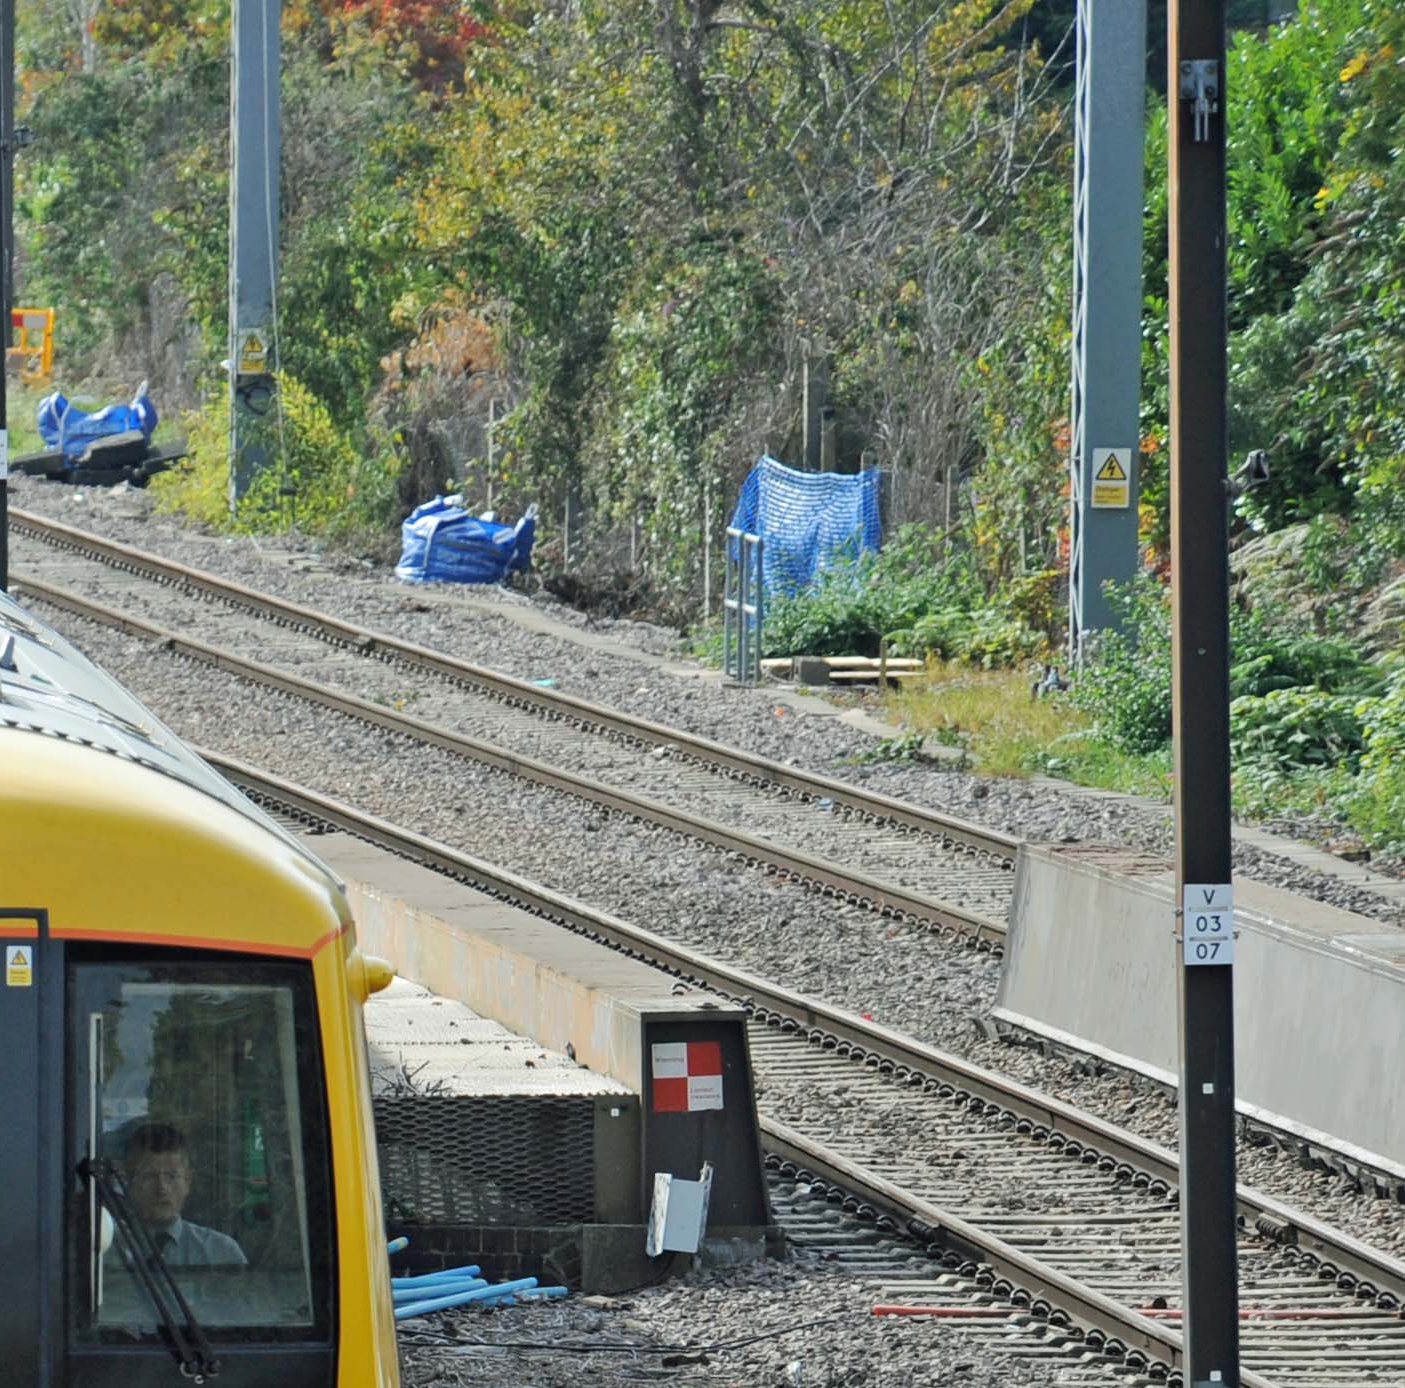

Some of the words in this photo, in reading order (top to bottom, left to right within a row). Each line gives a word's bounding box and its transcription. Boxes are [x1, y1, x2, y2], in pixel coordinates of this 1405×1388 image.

[1202, 888, 1216, 905] V
[1195, 915, 1222, 932] 03
[1195, 942, 1221, 960] 07
